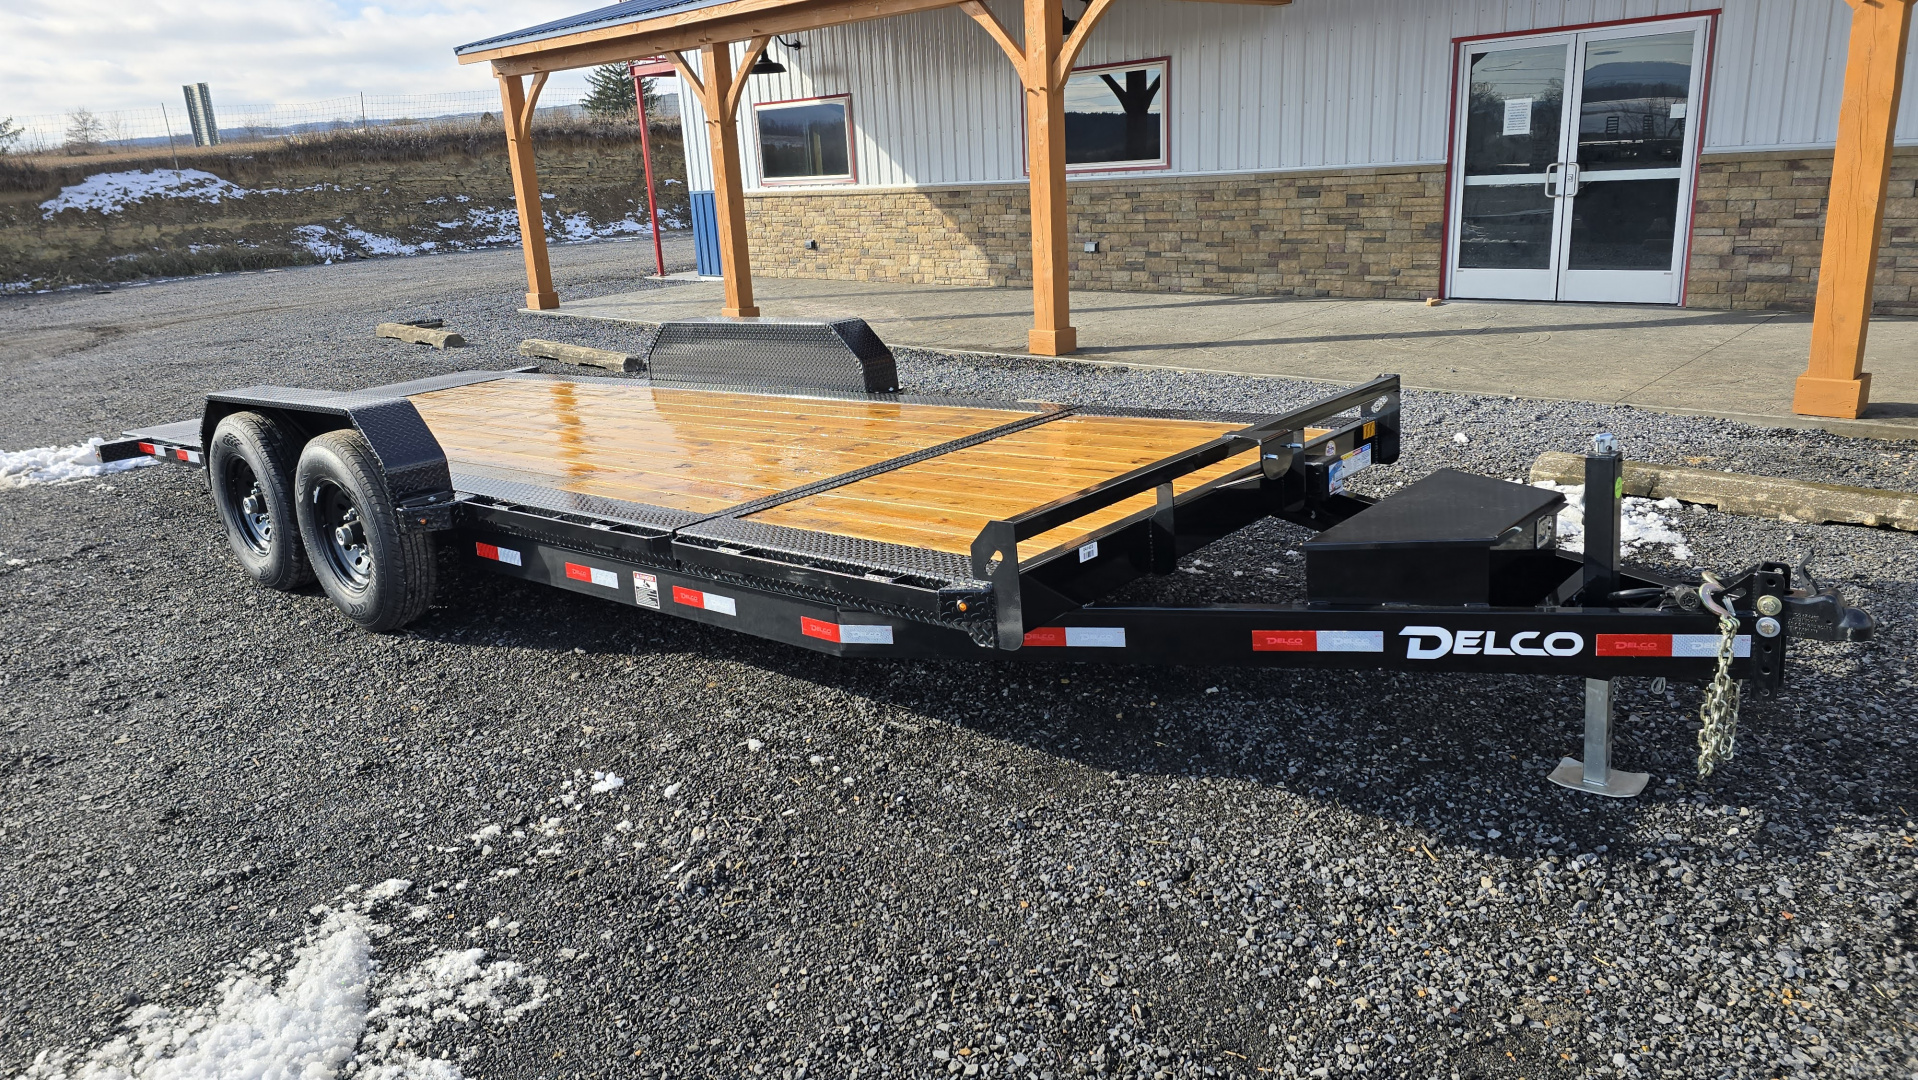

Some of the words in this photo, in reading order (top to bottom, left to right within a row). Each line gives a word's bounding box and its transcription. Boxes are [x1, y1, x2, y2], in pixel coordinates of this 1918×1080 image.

[810, 624, 832, 634] DELCO
[1265, 637, 1303, 645] DELCO
[1398, 626, 1584, 659] DELCO
[1614, 641, 1657, 650] DELCO
[1690, 641, 1729, 650] DEL
